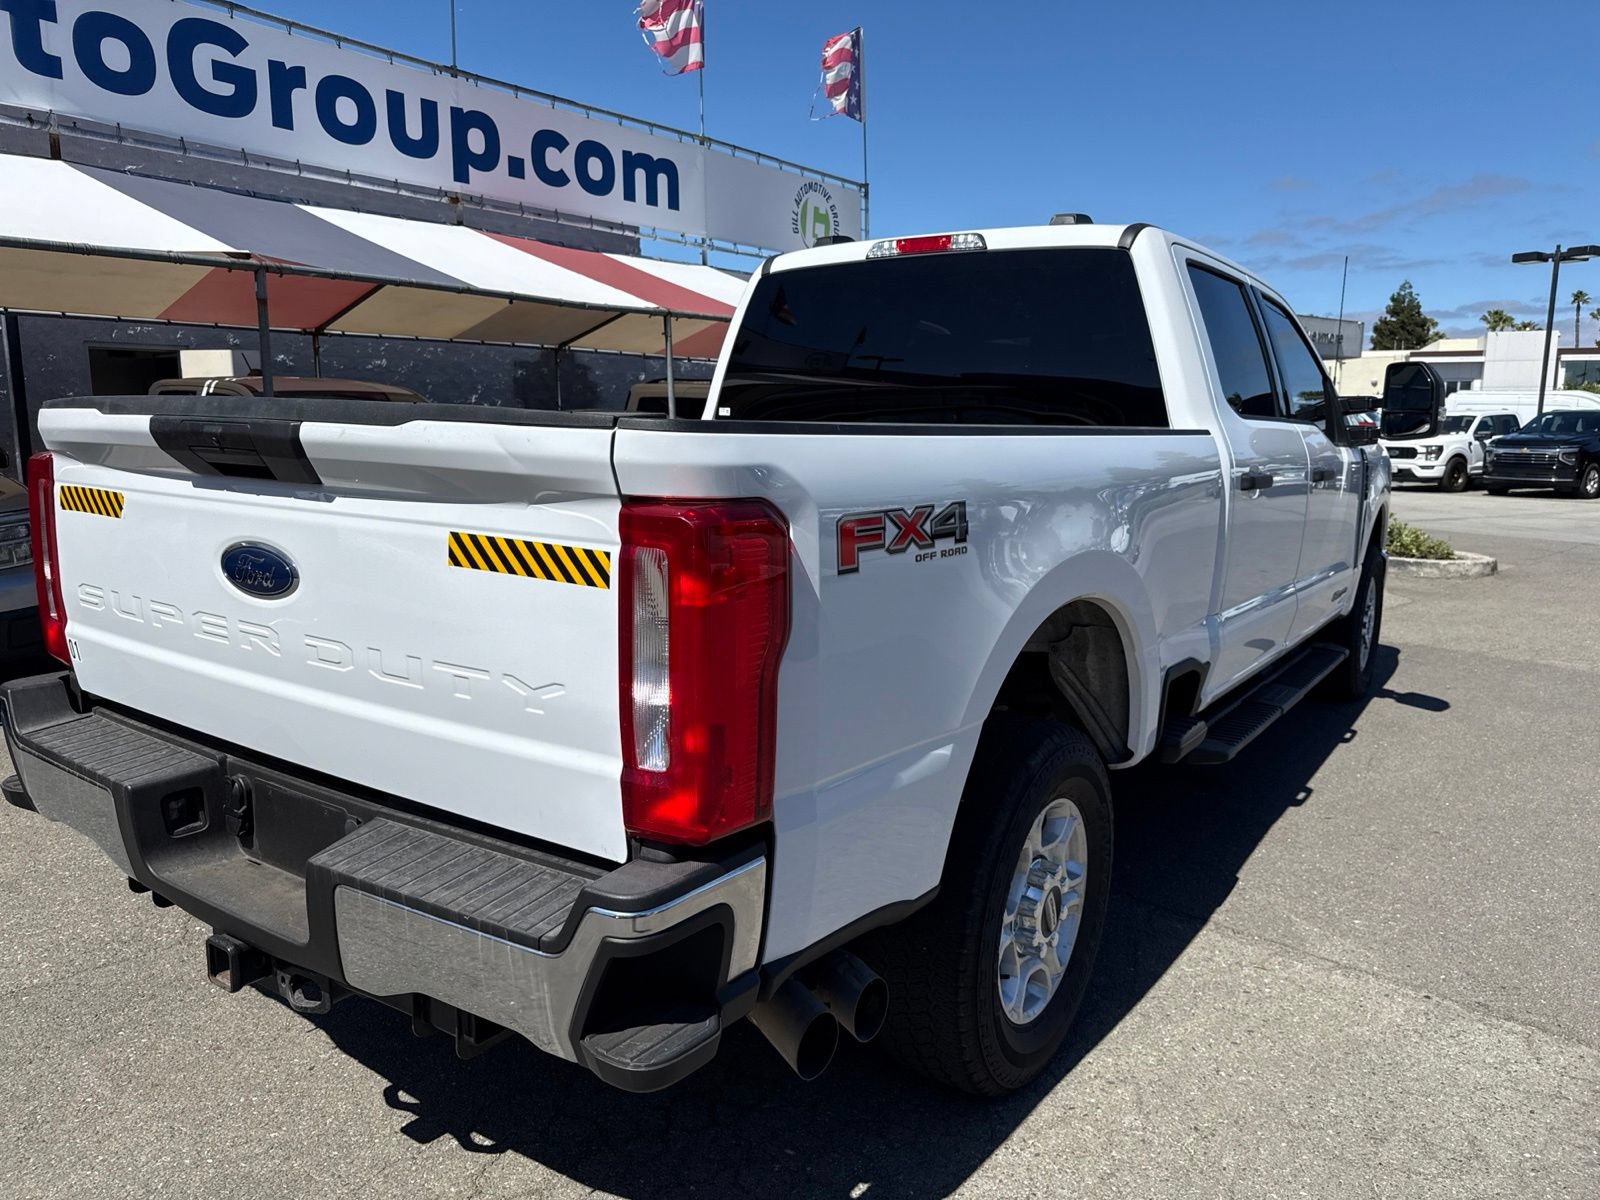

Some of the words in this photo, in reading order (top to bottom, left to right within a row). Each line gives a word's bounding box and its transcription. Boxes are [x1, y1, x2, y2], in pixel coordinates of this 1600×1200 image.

[794, 181, 832, 209] AUTOMOTIVE
[791, 210, 799, 234] GILL
[830, 204, 840, 236] GROU
[835, 500, 968, 576] FX4
[235, 553, 276, 588] Ford
[915, 551, 937, 563] OFF
[940, 546, 968, 559] ROAD
[78, 583, 281, 656] SUPER
[304, 633, 566, 715] DUTY
